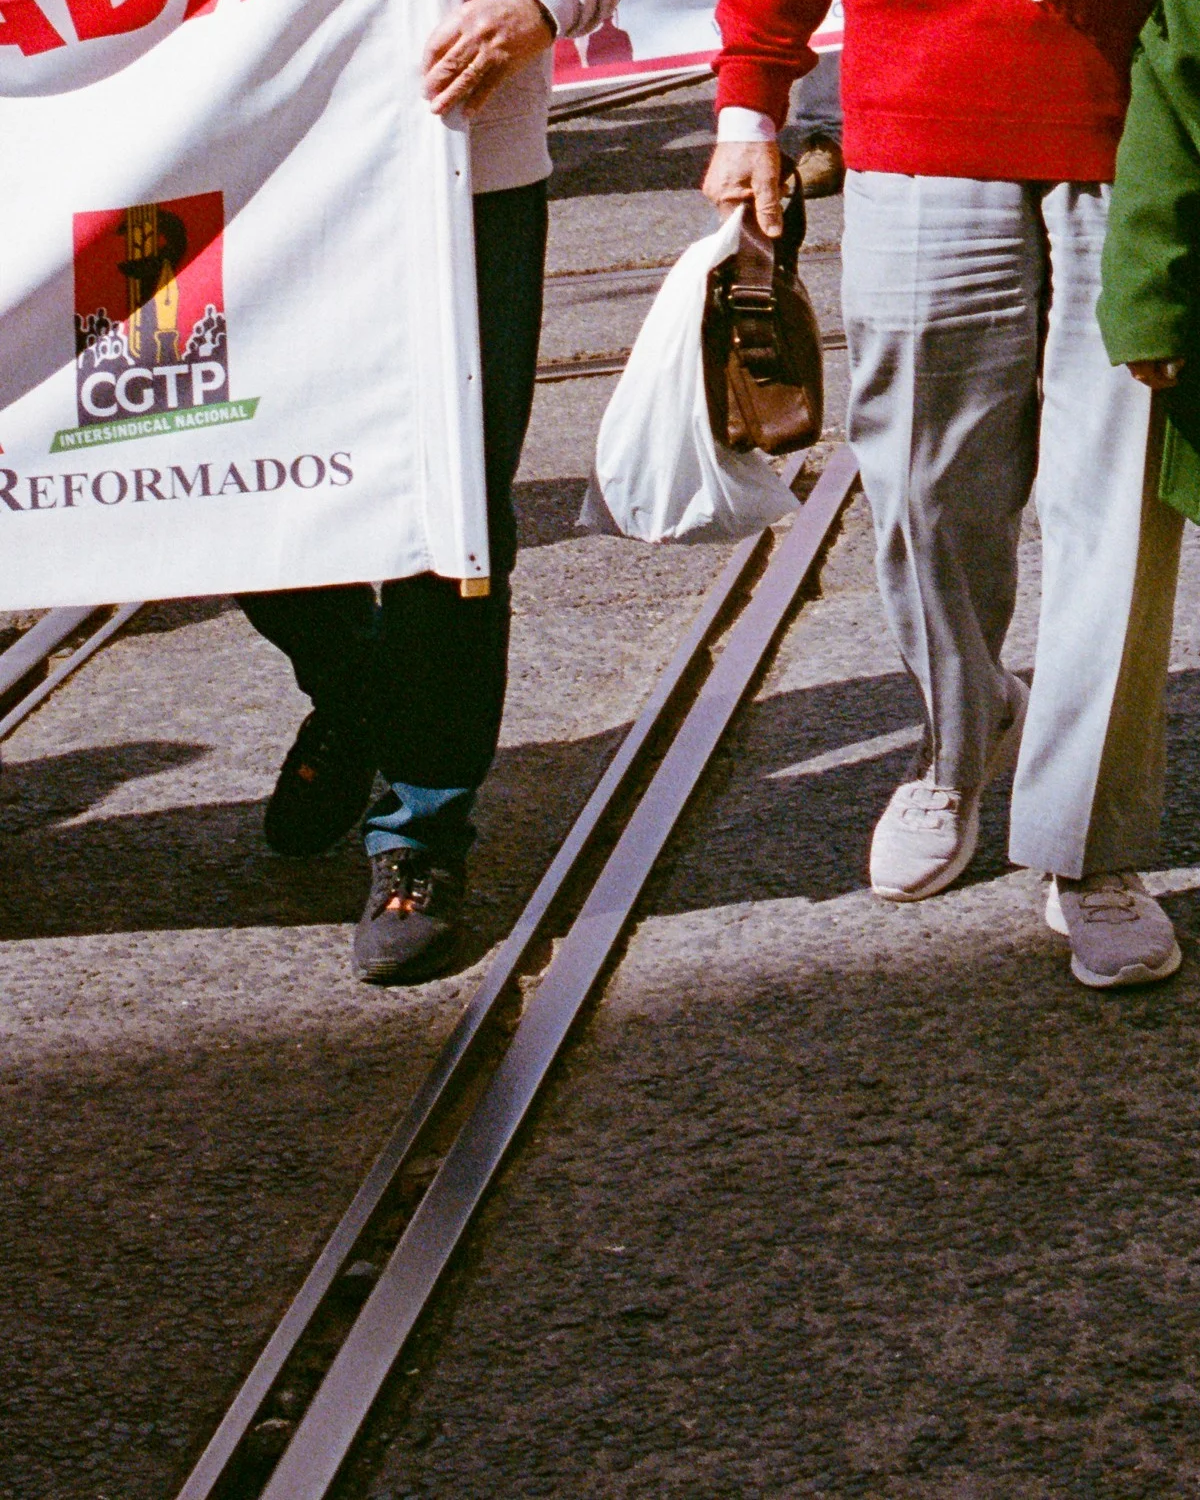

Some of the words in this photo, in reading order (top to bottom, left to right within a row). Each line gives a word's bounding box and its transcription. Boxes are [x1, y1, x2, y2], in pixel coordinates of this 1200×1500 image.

[80, 361, 227, 418] CGTP
[60, 417, 172, 449] INTERSINDICAL
[174, 404, 249, 431] NACIONAL
[0, 451, 355, 513] REFORMADOS
